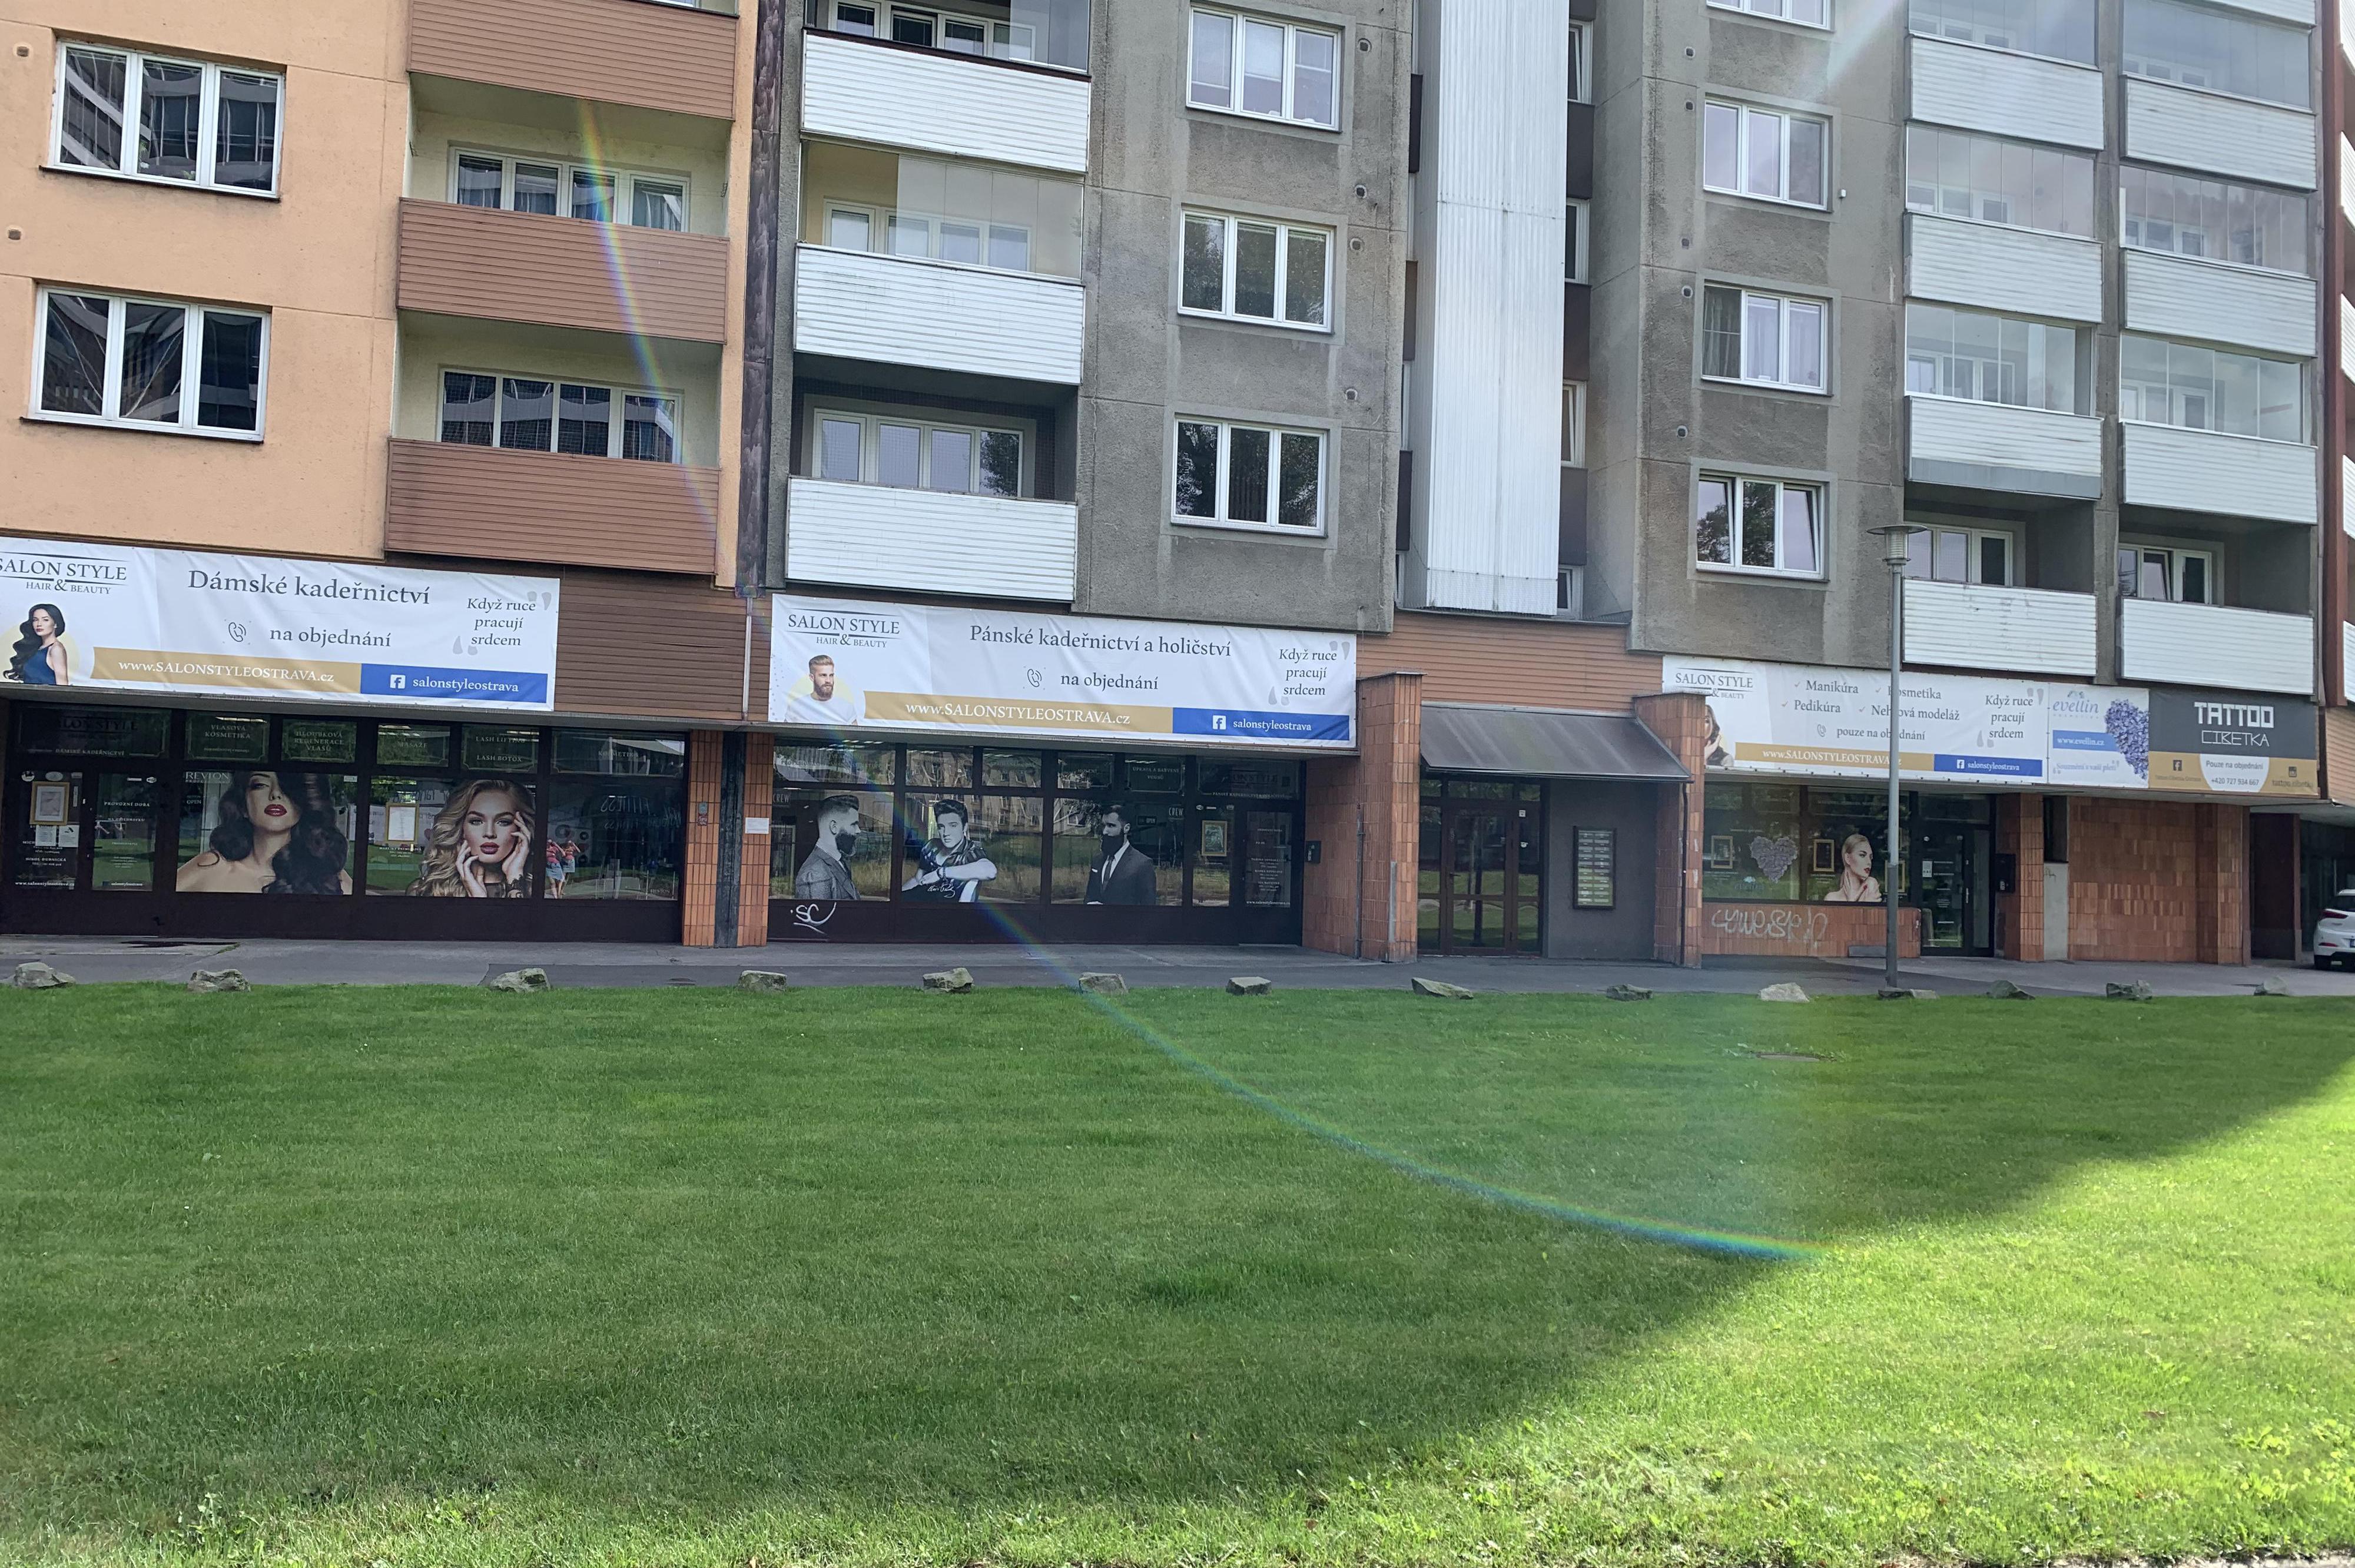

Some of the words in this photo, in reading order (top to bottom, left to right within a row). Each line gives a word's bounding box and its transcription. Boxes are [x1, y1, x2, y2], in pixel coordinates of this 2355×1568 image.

[67, 563, 127, 581] STYLE
[26, 581, 51, 591] HAIR
[54, 579, 68, 591] &
[70, 584, 111, 595] BEAUTY
[188, 569, 288, 595] Dámské
[294, 576, 430, 605] kadeřnictví
[467, 597, 502, 612] Když
[506, 601, 536, 611] ruce
[475, 616, 523, 630] pracují
[788, 614, 845, 631] SALON
[850, 618, 901, 635] STYLE
[270, 629, 295, 642] na
[298, 626, 392, 648] objednání
[471, 634, 522, 646] srdcem
[816, 636, 838, 645] HAIR
[840, 633, 851, 647] &
[854, 639, 888, 648] BEAUTY
[970, 625, 1034, 645] Pánské
[1039, 628, 1140, 651] kadeřnictví
[1144, 641, 1154, 652] a
[1159, 636, 1231, 657] holičství
[1279, 648, 1309, 663] Když
[1312, 652, 1337, 661] ruce
[118, 661, 334, 683] www.SALONSTYLEOSTRAVA.cz
[1286, 667, 1327, 681] pracují
[413, 676, 519, 693] salonstyleostrava
[1060, 674, 1080, 686] na
[1084, 672, 1159, 692] objednání
[1676, 672, 1716, 685] SALON
[1718, 675, 1753, 688] STYLE
[1283, 685, 1325, 696] srdcem
[1711, 688, 1720, 697] &
[1806, 680, 1859, 694] Manikúra
[1888, 685, 1942, 700] smetika
[1985, 695, 2011, 707] Když
[2012, 698, 2034, 707] ruce
[2053, 700, 2099, 713] evellin
[905, 702, 1130, 725] www.SALONSTYLEOSTRAVA.cz
[1794, 700, 1841, 713] Pedikúra
[1872, 705, 1915, 718] Nehová
[1918, 708, 1960, 721] modeláž
[2194, 702, 2274, 728] TATTOO
[1233, 718, 1312, 732] salonstyleostrava
[1991, 712, 2025, 725] pracují
[1837, 728, 1865, 738] pouze
[1880, 728, 1926, 740] obdnání
[1989, 728, 2024, 739] srdcem
[1967, 761, 2020, 771] salonstyleostrava
[1168, 807, 1184, 816] CREW
